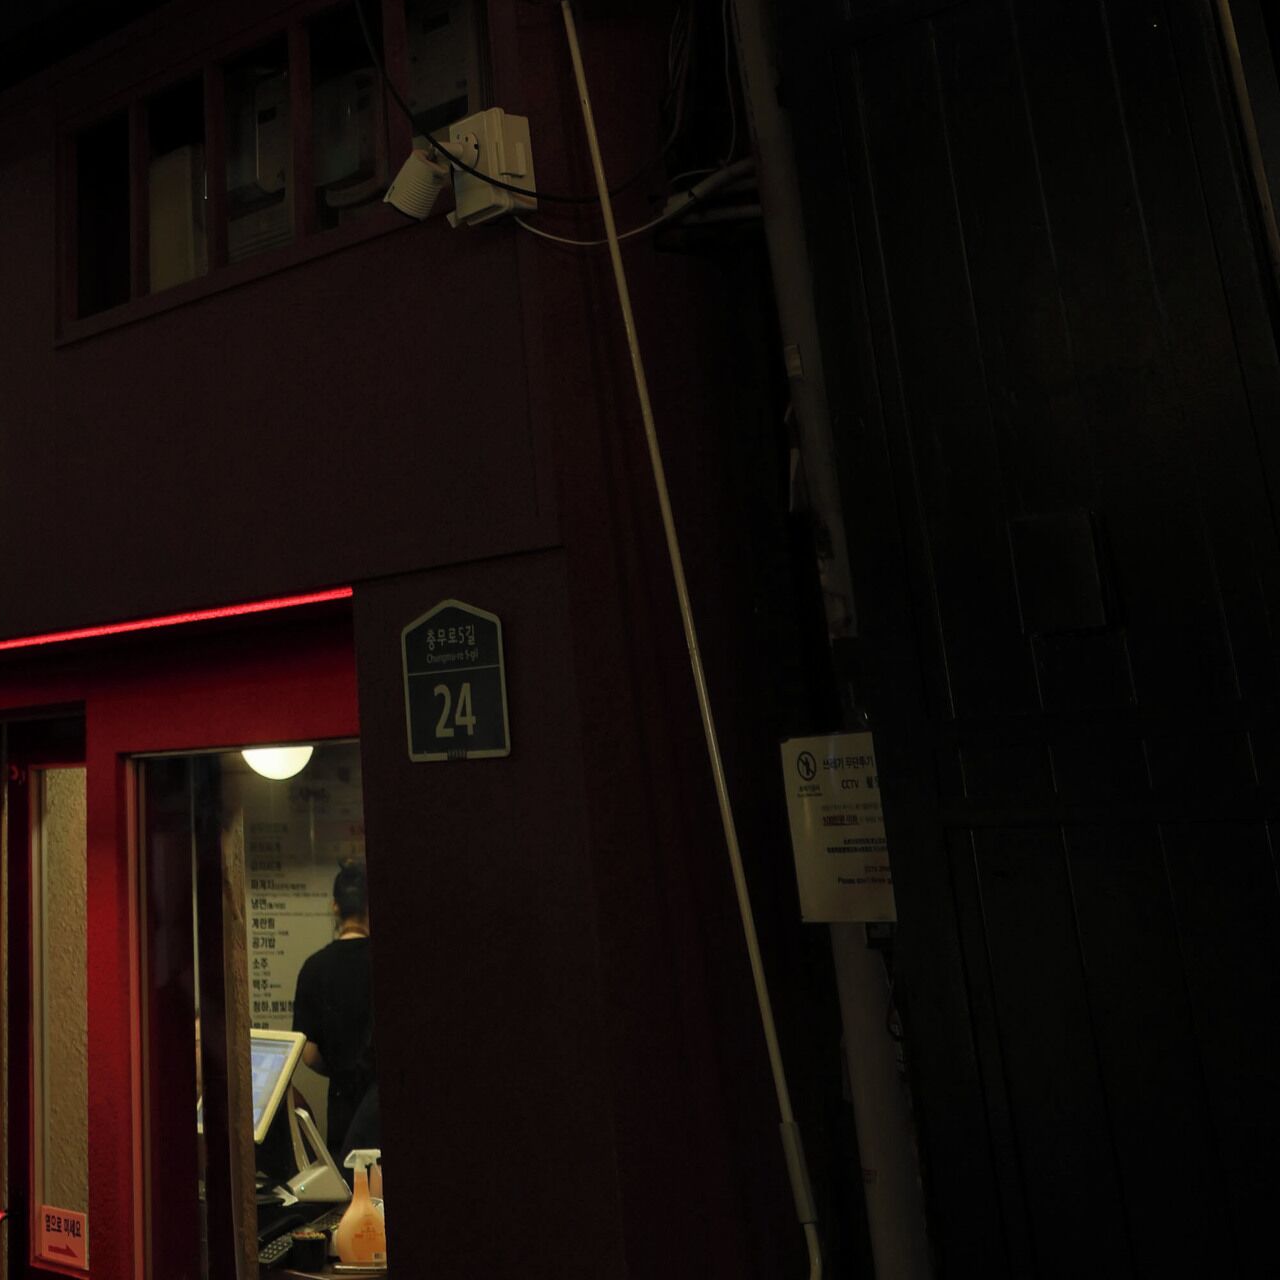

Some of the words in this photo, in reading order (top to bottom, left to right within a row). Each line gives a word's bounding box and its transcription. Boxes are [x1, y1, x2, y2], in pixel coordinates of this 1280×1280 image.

[426, 625, 476, 651] 충무로5길
[434, 682, 476, 738] 24
[841, 778, 859, 790] CCTV
[253, 957, 268, 970] 소주
